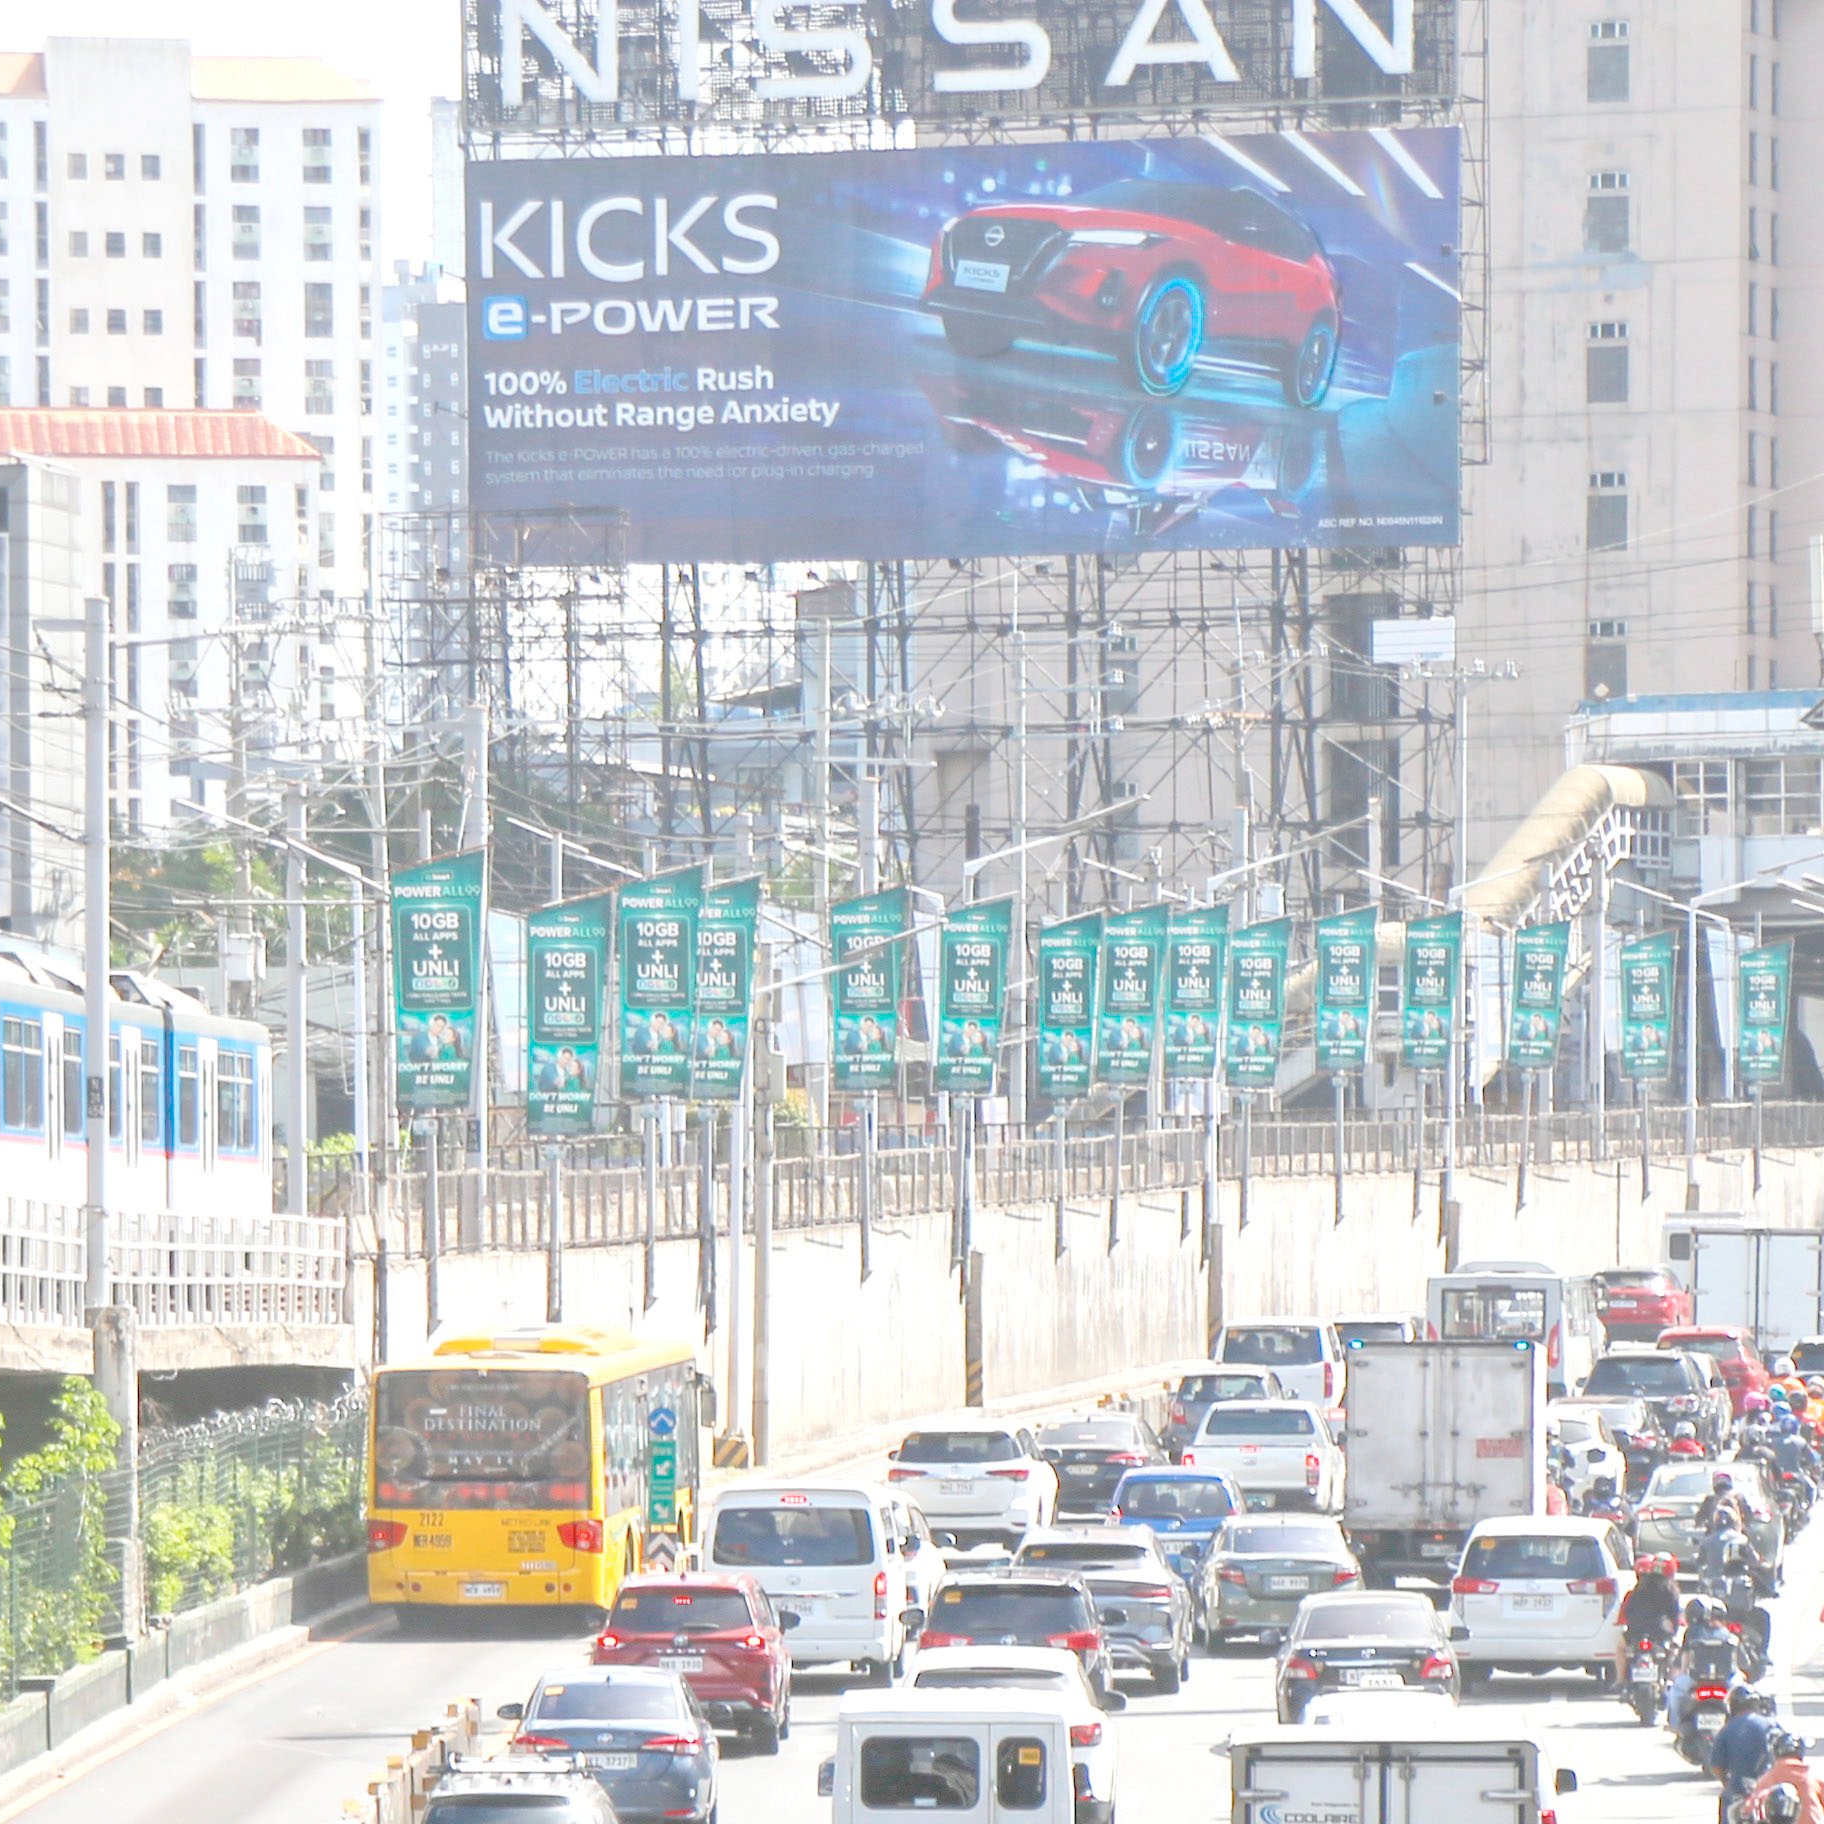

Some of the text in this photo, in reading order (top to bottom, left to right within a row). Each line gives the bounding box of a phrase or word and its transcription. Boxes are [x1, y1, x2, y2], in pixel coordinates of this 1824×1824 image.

[499, 0, 1413, 104] NISSAN
[480, 193, 782, 282] KICKS
[487, 296, 781, 335] e-POWER
[483, 363, 775, 398] 100% Electric Rush
[483, 396, 841, 432] Without Range Anxiety
[485, 450, 512, 463] The
[631, 447, 658, 461] has
[662, 450, 671, 460] a
[485, 471, 541, 486] system
[544, 468, 574, 482] that
[657, 466, 682, 479] the
[687, 465, 723, 479] need
[394, 884, 466, 898] POWER ALL
[622, 897, 664, 909] POWER
[411, 912, 460, 930] 10GB
[413, 931, 458, 942] ALL APPS
[530, 926, 573, 938] POWER
[637, 922, 680, 938] 10GB
[697, 932, 737, 947] 10GB
[955, 944, 992, 958] 10GB
[1113, 946, 1148, 960] 10GB
[412, 959, 460, 977] UNLI
[544, 952, 587, 969] 10GB
[638, 964, 679, 979] UNLI
[697, 971, 736, 987] UNLI
[848, 973, 886, 988] UNLI
[955, 979, 990, 993] UNLI
[1113, 980, 1147, 992] UNLI
[544, 996, 586, 1012] UNLI
[459, 1404, 505, 1417] FINAL
[424, 1417, 542, 1433] DESTINATION
[448, 1456, 514, 1466] MAY 14
[419, 1512, 444, 1527] 2122
[1368, 1678, 1393, 1686] TAXI
[1285, 1813, 1359, 1824] COOLAIRE
